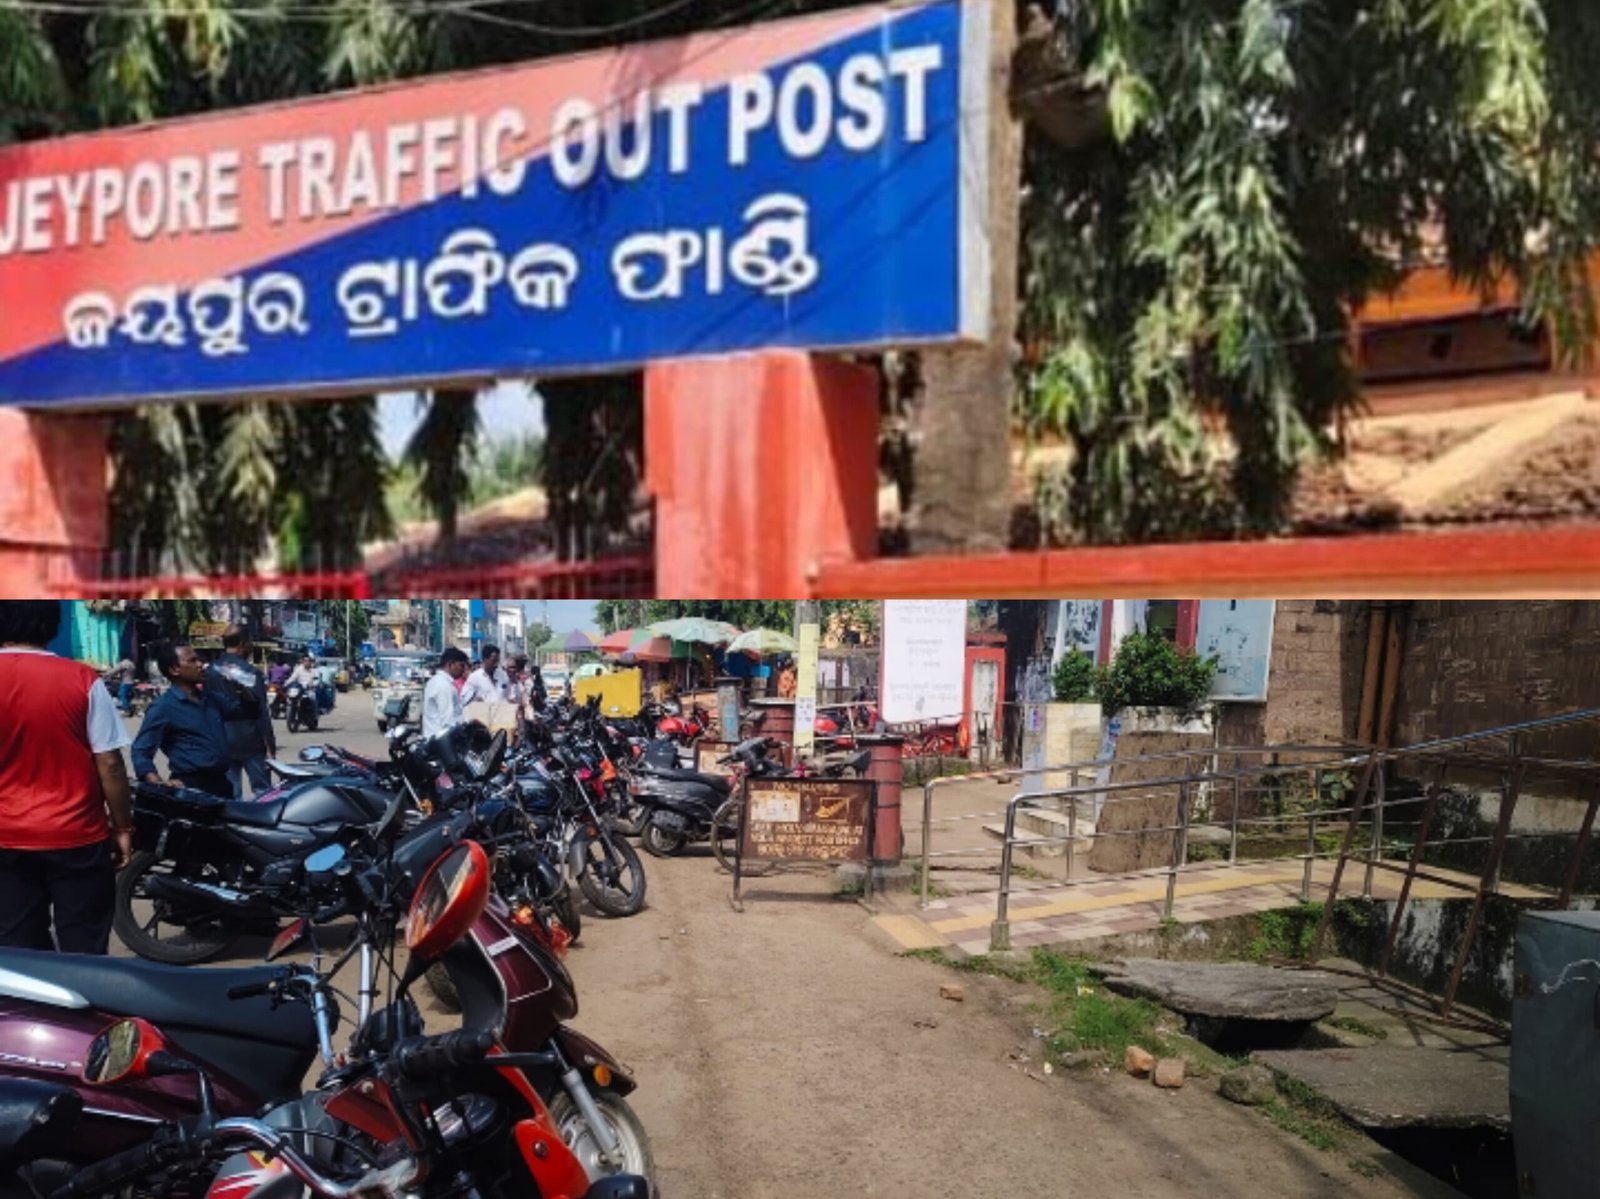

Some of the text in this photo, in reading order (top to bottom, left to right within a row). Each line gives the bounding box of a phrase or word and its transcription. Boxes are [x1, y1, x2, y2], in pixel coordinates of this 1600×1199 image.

[0, 44, 943, 256] JEYPORE TRAFFIC OUT POST
[63, 192, 820, 356] ଜୟପୁର ଟ୍ରାଫିକ ଫାଣ୍ଡି
